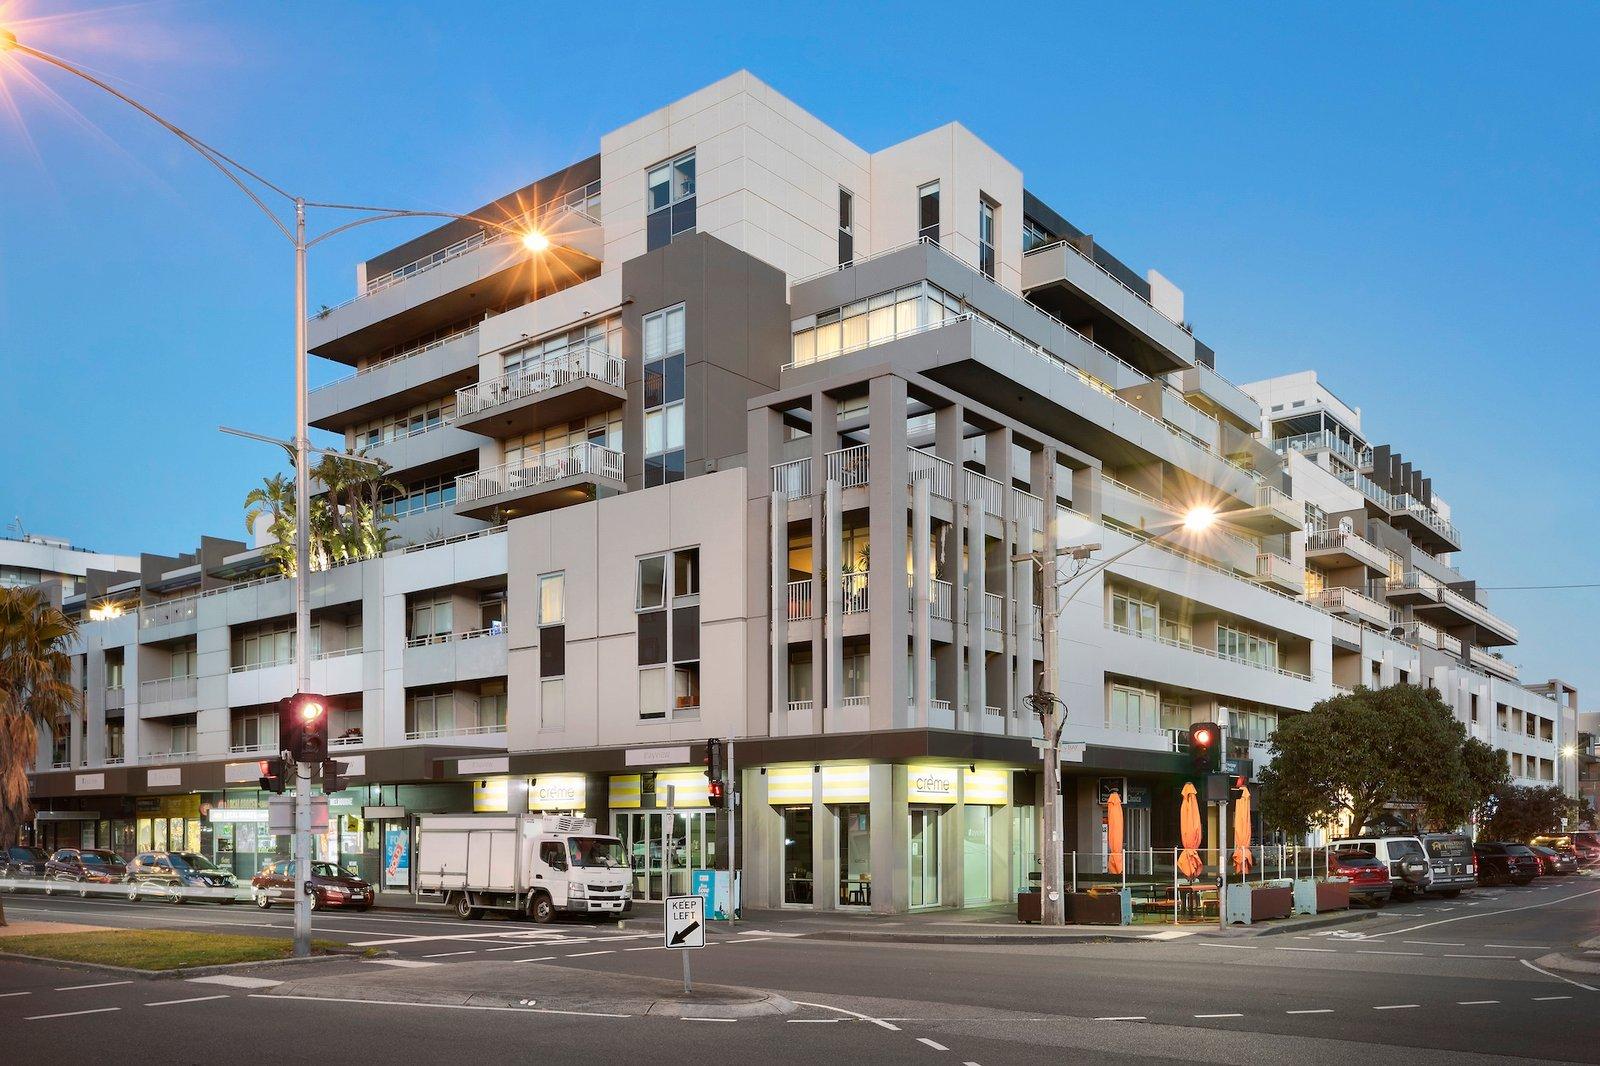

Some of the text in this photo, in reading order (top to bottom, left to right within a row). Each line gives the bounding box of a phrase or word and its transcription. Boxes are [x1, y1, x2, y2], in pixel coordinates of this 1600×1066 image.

[916, 773, 950, 791] crème
[672, 900, 697, 910] KEEP
[673, 911, 696, 921] LEFT
